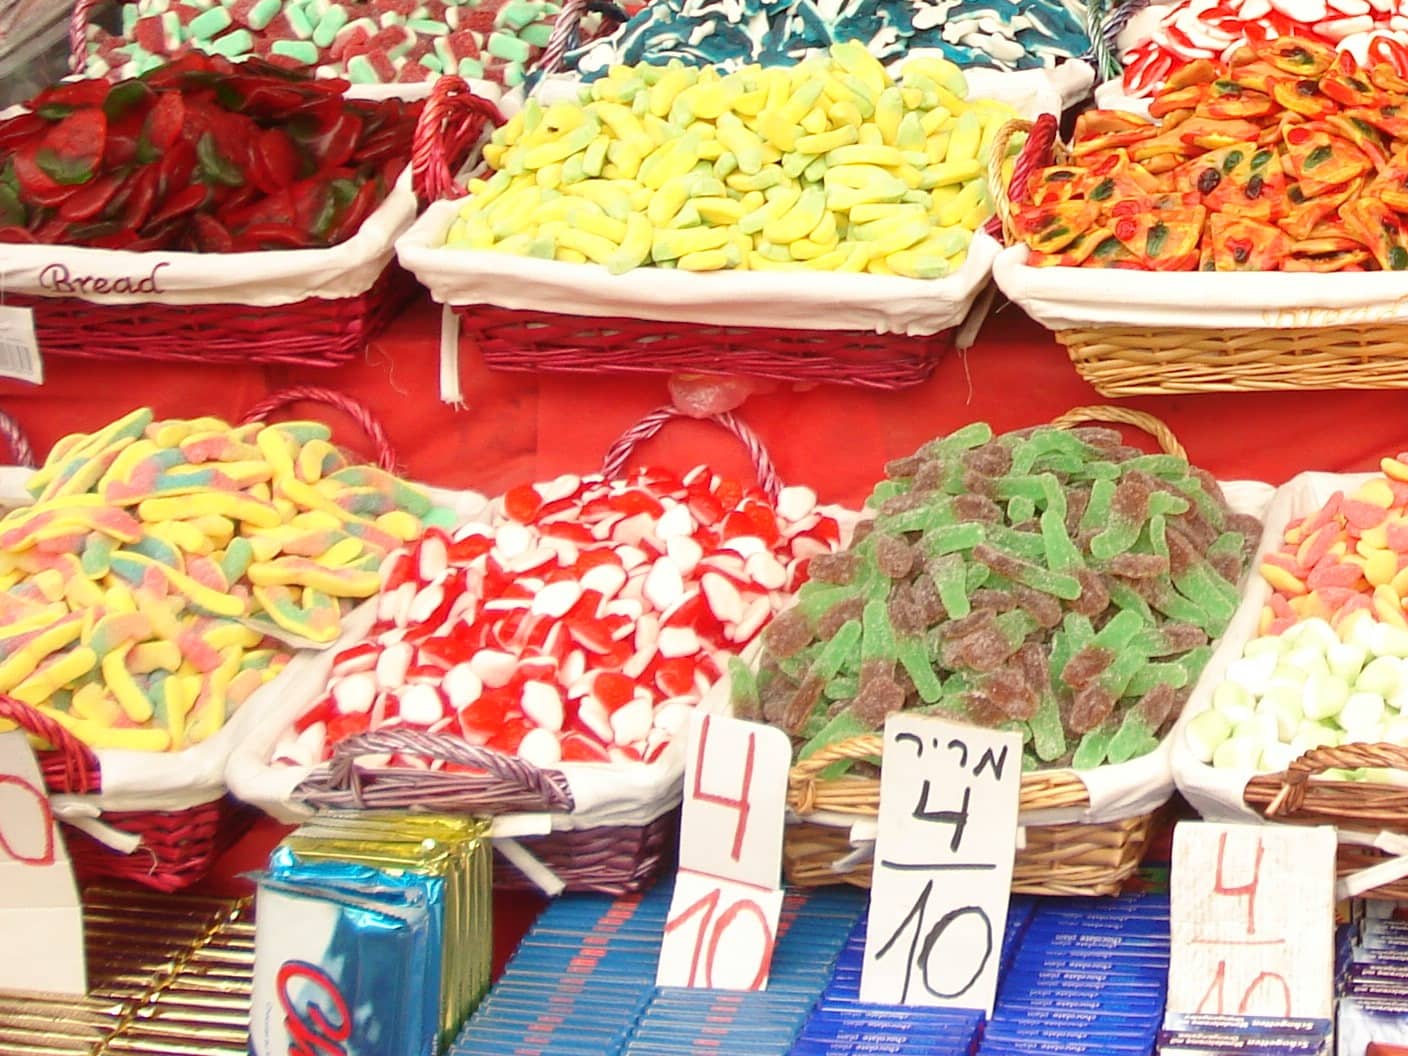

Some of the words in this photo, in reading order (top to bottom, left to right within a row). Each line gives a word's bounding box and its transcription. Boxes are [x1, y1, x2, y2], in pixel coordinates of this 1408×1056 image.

[39, 263, 170, 295] Bread
[693, 714, 756, 862] 4
[912, 779, 970, 852] 4
[1214, 831, 1265, 935] 4
[663, 887, 776, 991] 10
[875, 879, 993, 1005] 10
[1197, 960, 1292, 1018] 10
